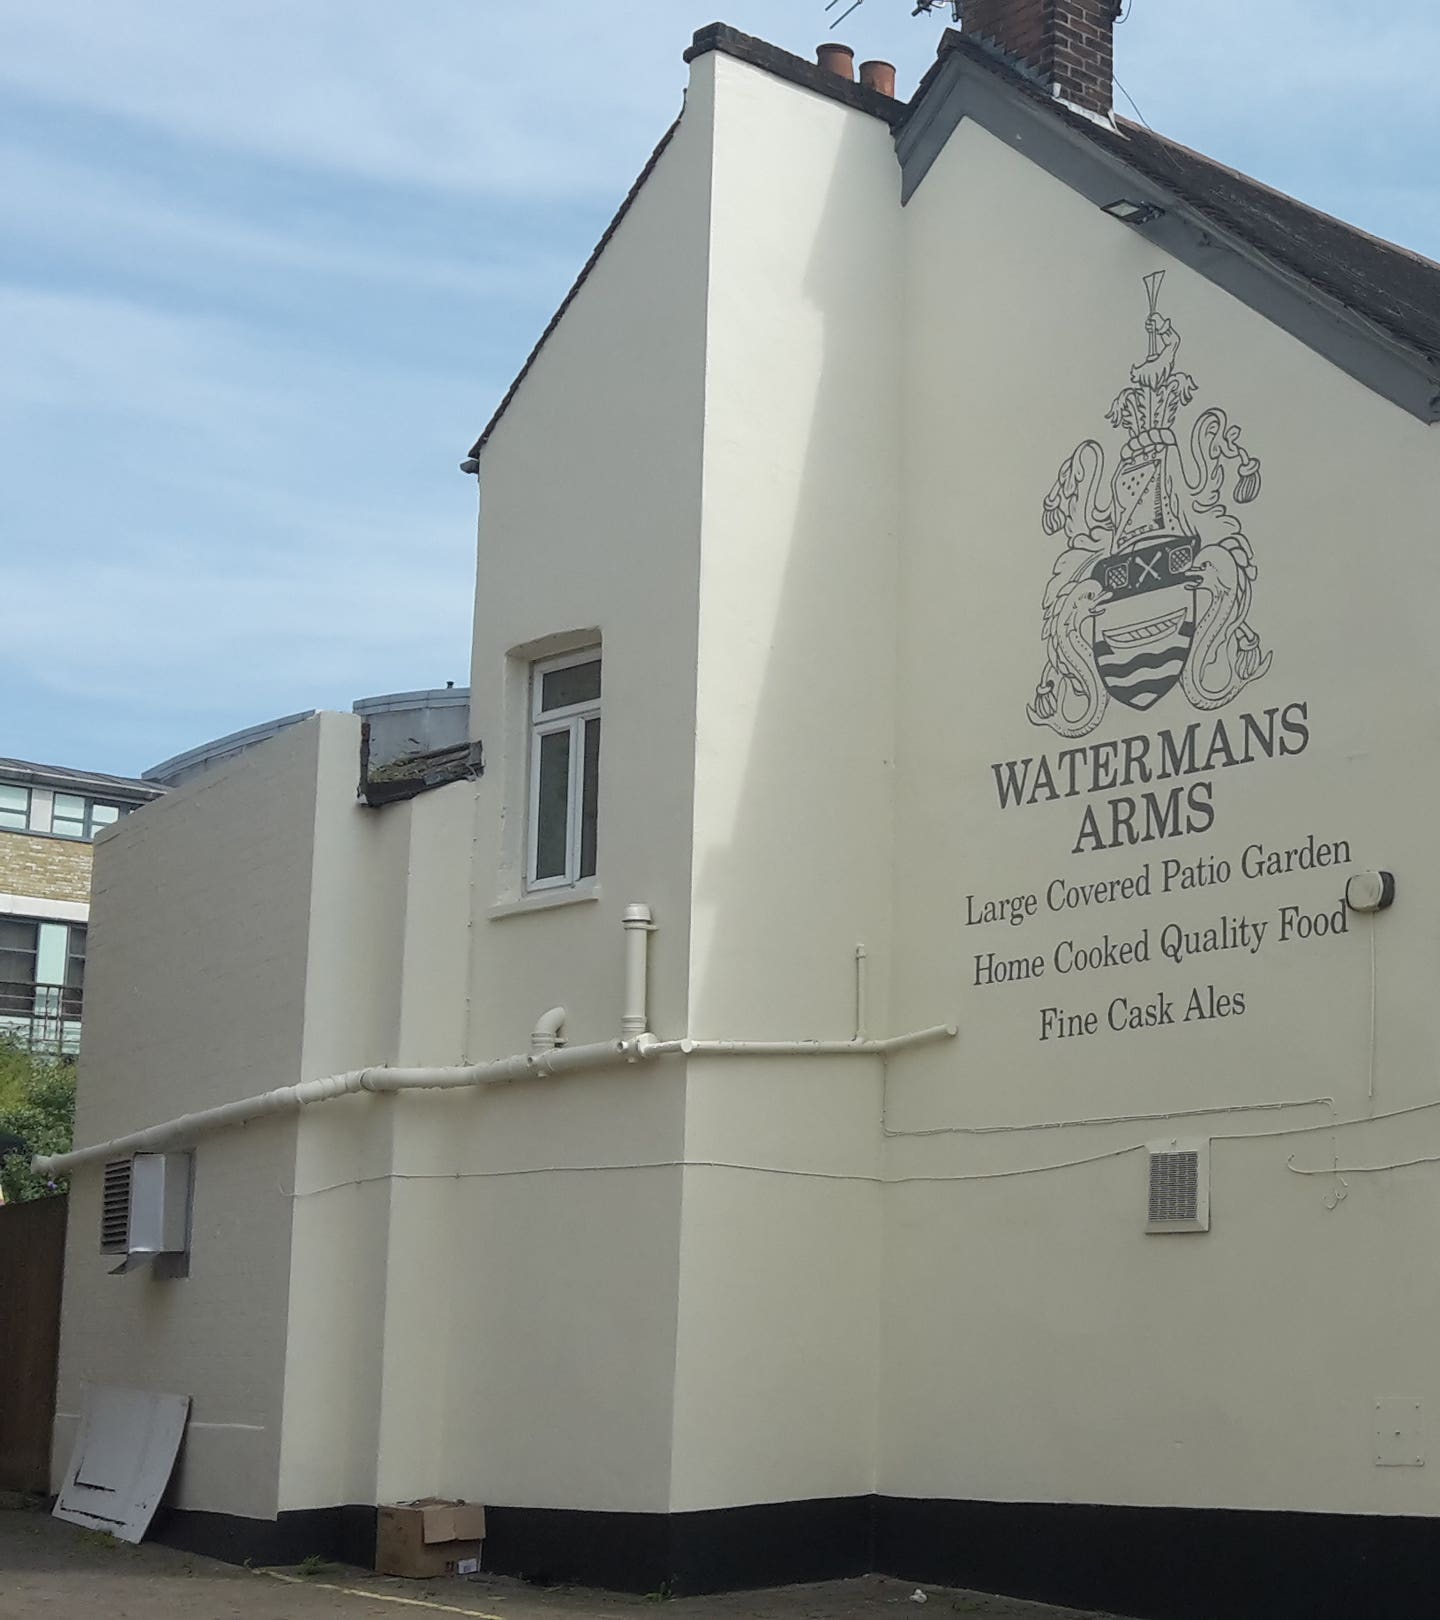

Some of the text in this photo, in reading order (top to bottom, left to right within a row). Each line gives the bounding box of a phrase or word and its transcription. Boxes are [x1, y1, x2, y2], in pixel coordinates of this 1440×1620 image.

[991, 701, 1310, 809] WATERMANS
[1071, 781, 1215, 854] ARMS
[965, 834, 1351, 927] Large Covered Patio Garden
[973, 899, 1350, 986] Home Cooked Quality Food
[1039, 984, 1246, 1042] Fine Cask Ales
